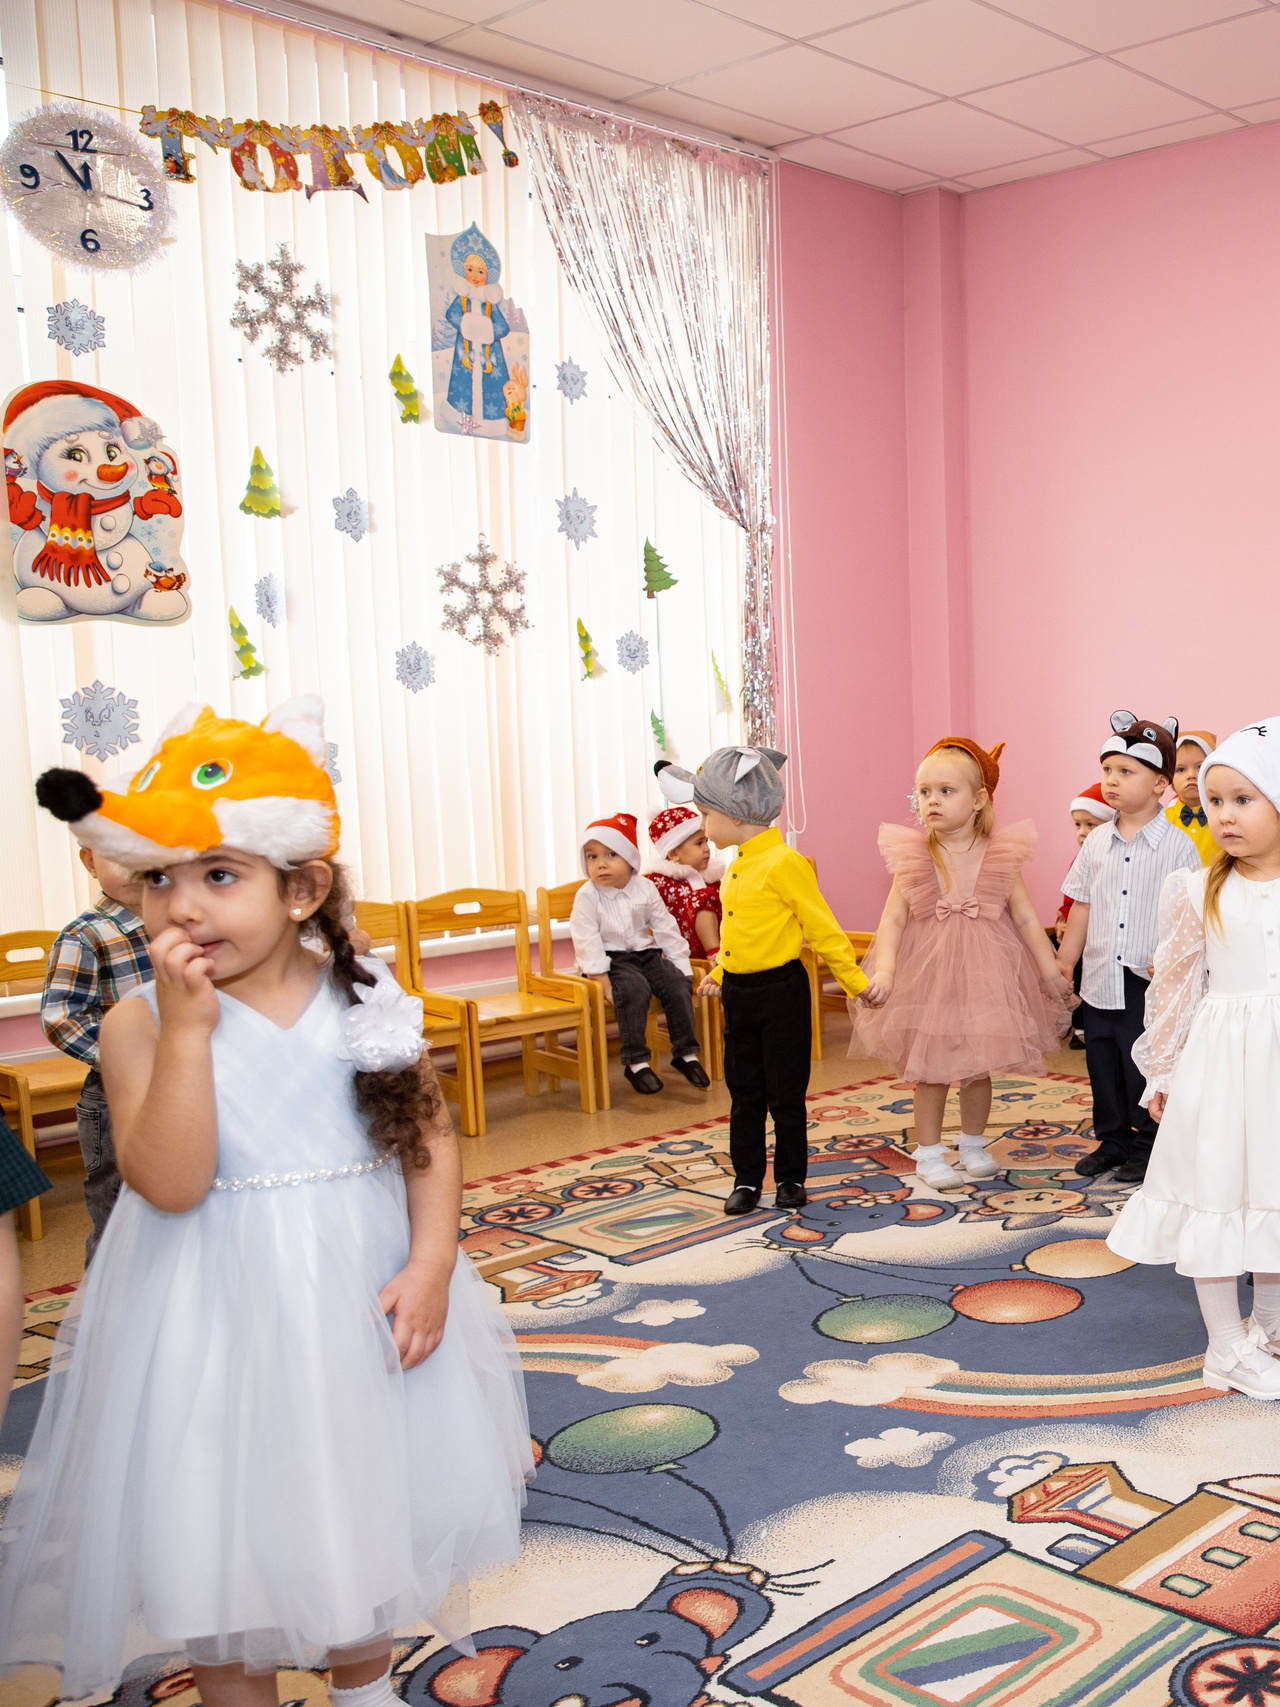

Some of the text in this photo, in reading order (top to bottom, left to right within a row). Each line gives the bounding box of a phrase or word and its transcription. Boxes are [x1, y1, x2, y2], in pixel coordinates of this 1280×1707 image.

[66, 129, 98, 153] 12
[19, 163, 41, 190] 9
[138, 188, 154, 211] 3
[80, 228, 101, 253] 6
